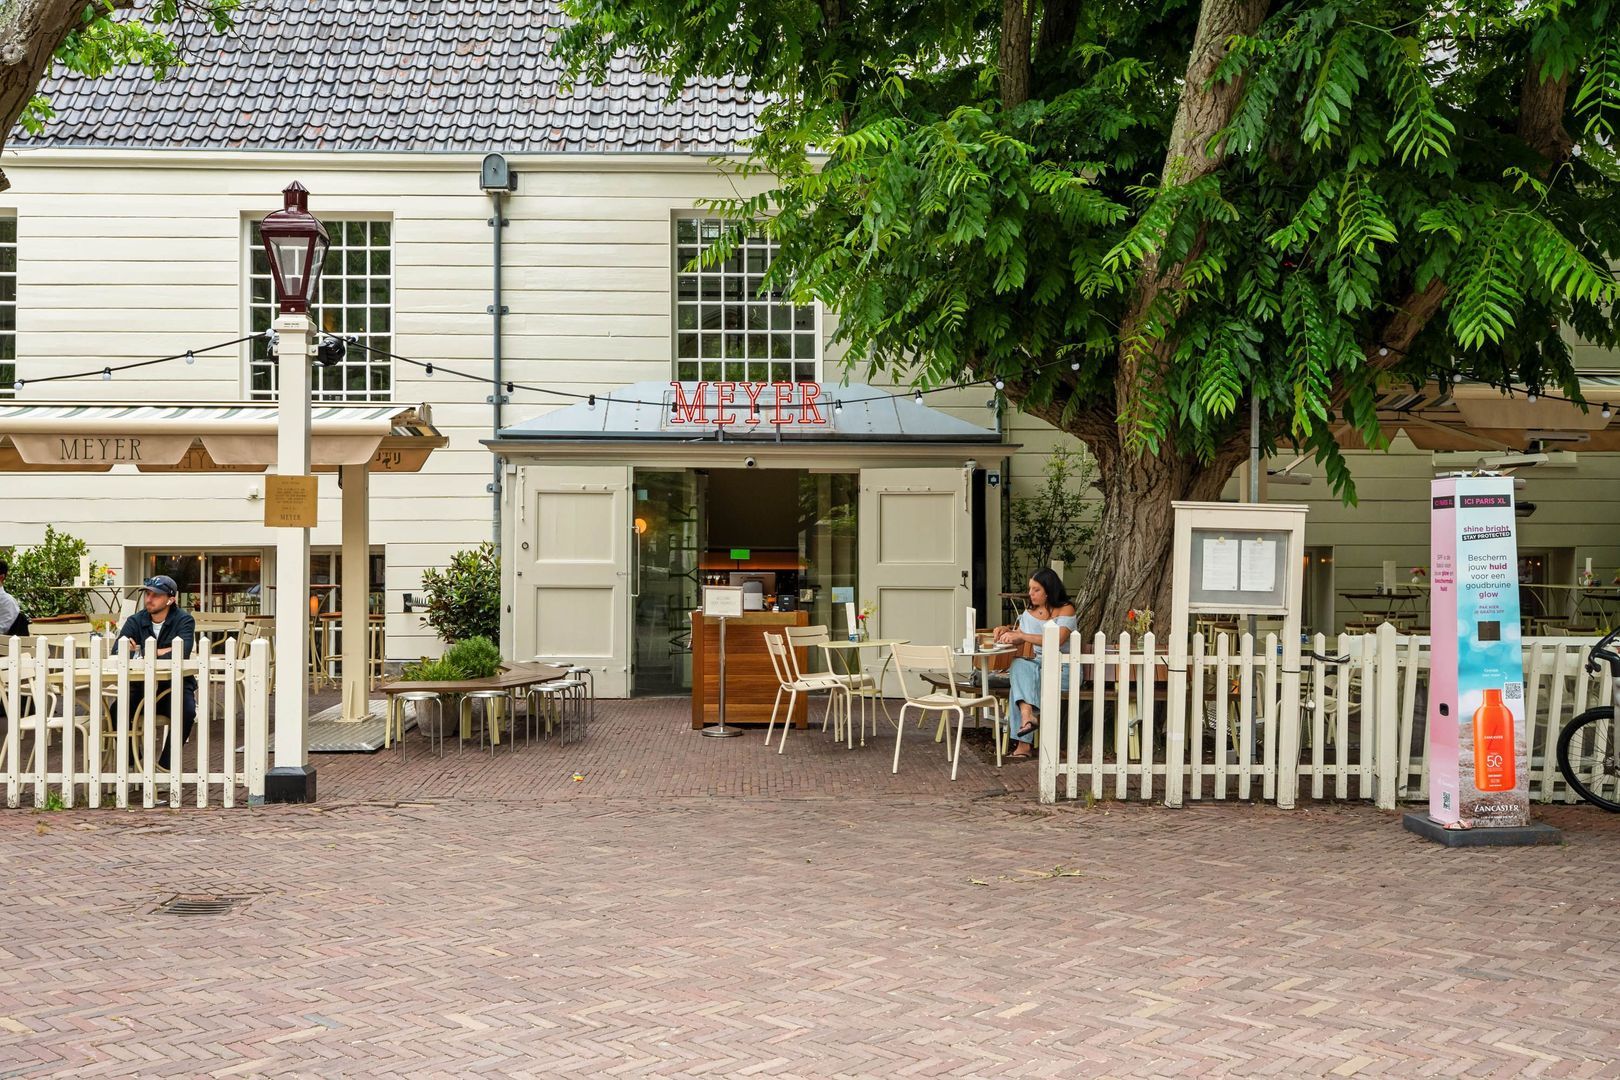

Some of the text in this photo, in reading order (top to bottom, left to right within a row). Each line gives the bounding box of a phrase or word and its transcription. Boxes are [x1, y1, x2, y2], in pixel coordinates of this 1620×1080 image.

[670, 381, 826, 424] MEYER
[59, 438, 142, 460] MEYER
[1477, 531, 1511, 539] PROTECTED
[1465, 582, 1511, 590] goudbruine
[1479, 591, 1499, 599] glow
[1487, 755, 1502, 767] 50
[1474, 804, 1519, 812] LANCASTER
